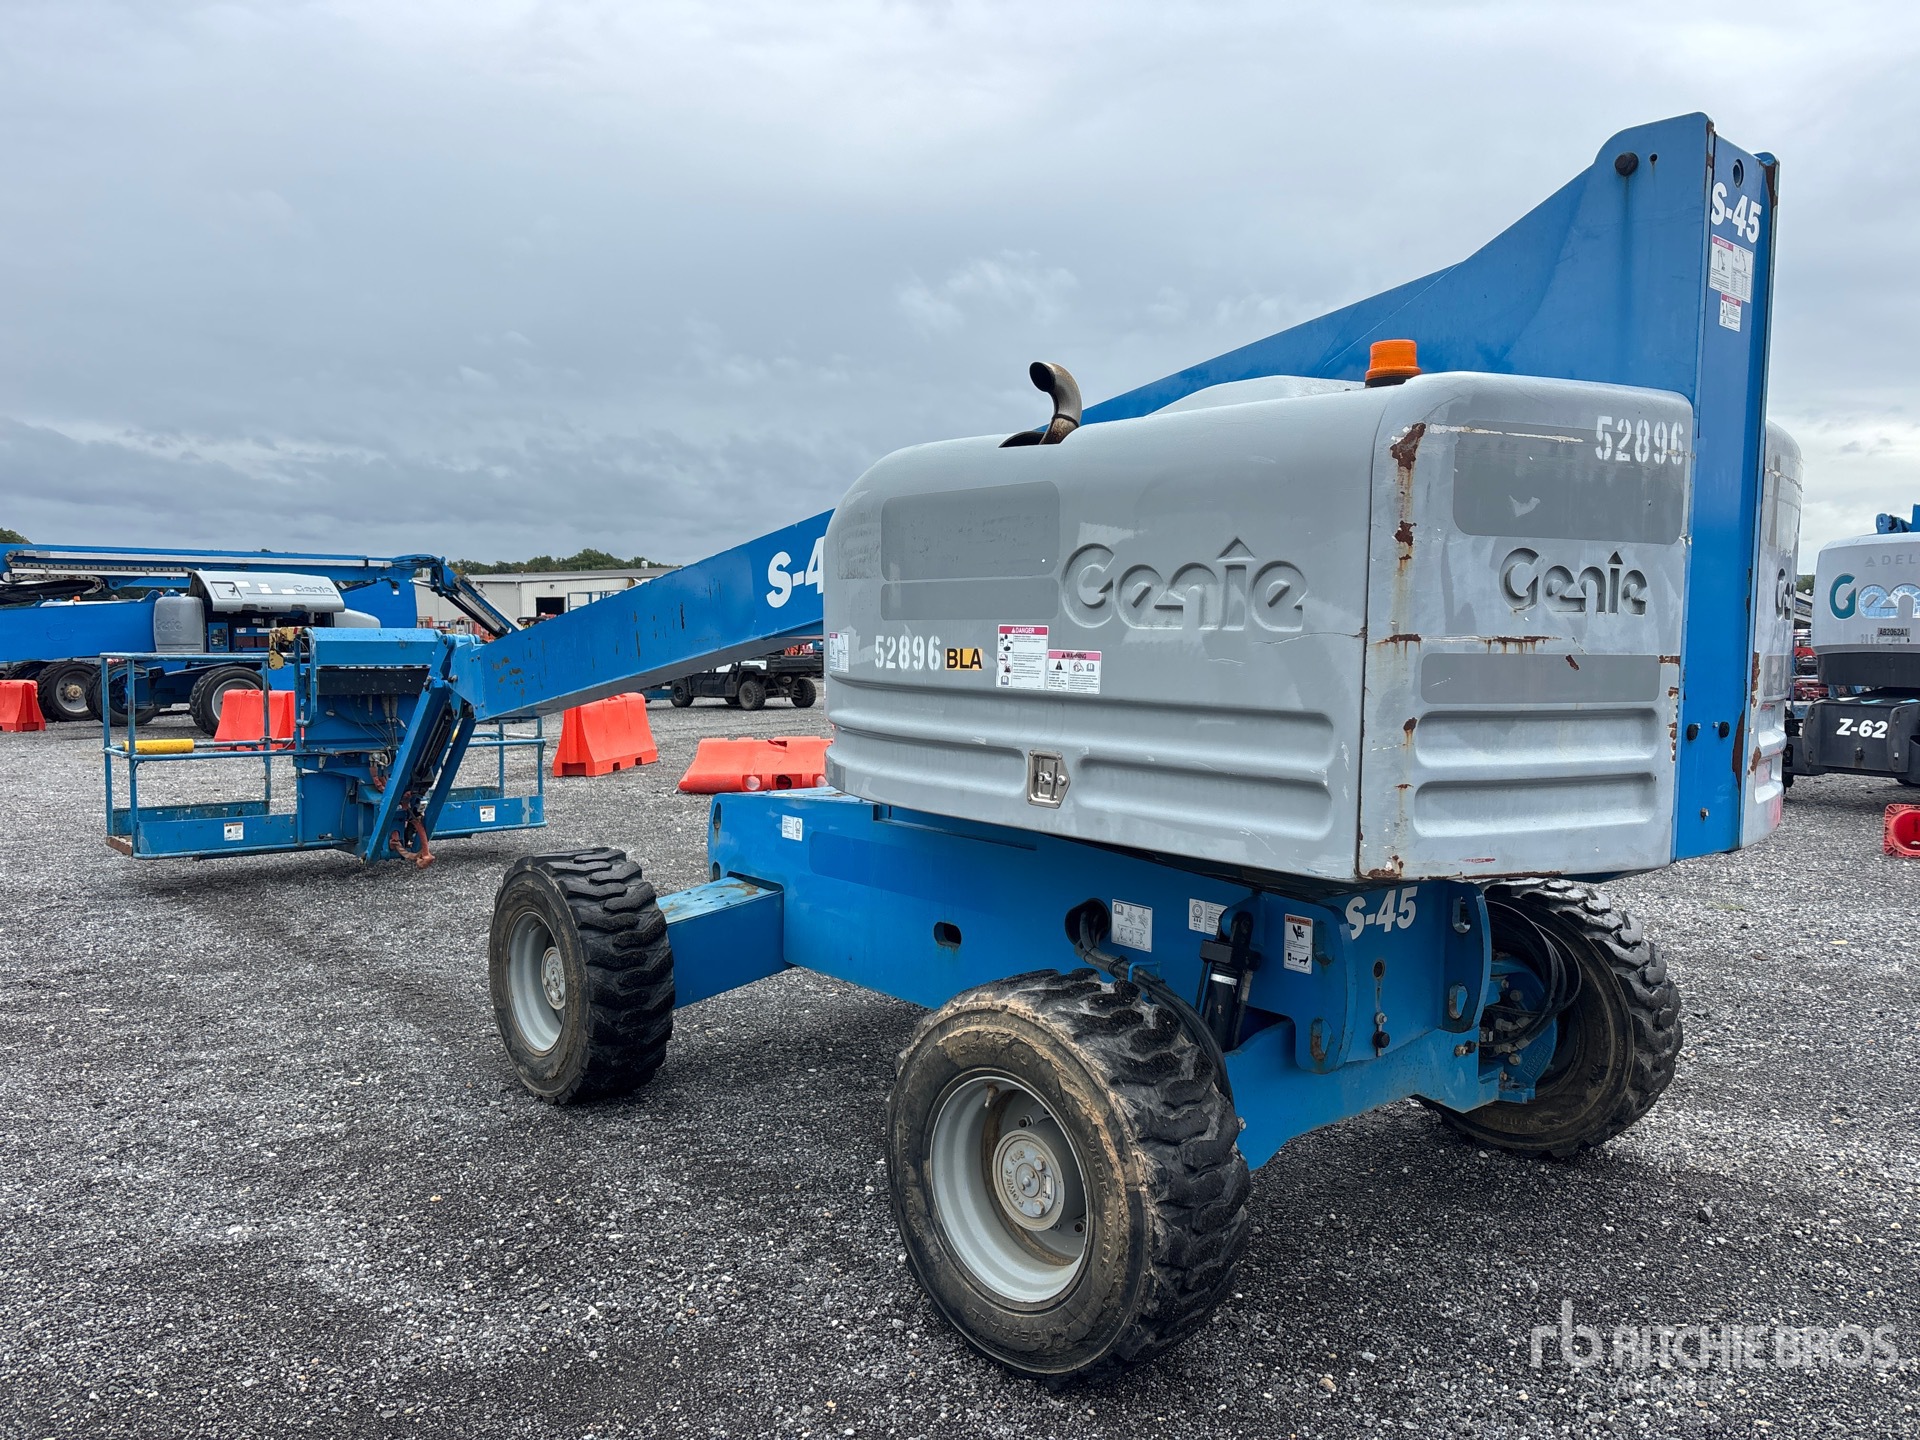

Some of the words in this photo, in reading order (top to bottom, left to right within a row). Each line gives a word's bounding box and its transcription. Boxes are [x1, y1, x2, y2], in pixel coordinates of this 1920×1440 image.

[1711, 182, 1762, 243] S-45
[1594, 415, 1685, 465] 52896
[1060, 536, 1309, 632] Genie
[1498, 547, 1648, 616] Genie
[1881, 554, 1920, 566] DEL
[874, 635, 941, 671] 52896
[946, 648, 983, 669] BLA
[1836, 717, 1888, 739] Z-62
[1345, 886, 1418, 940] S-45
